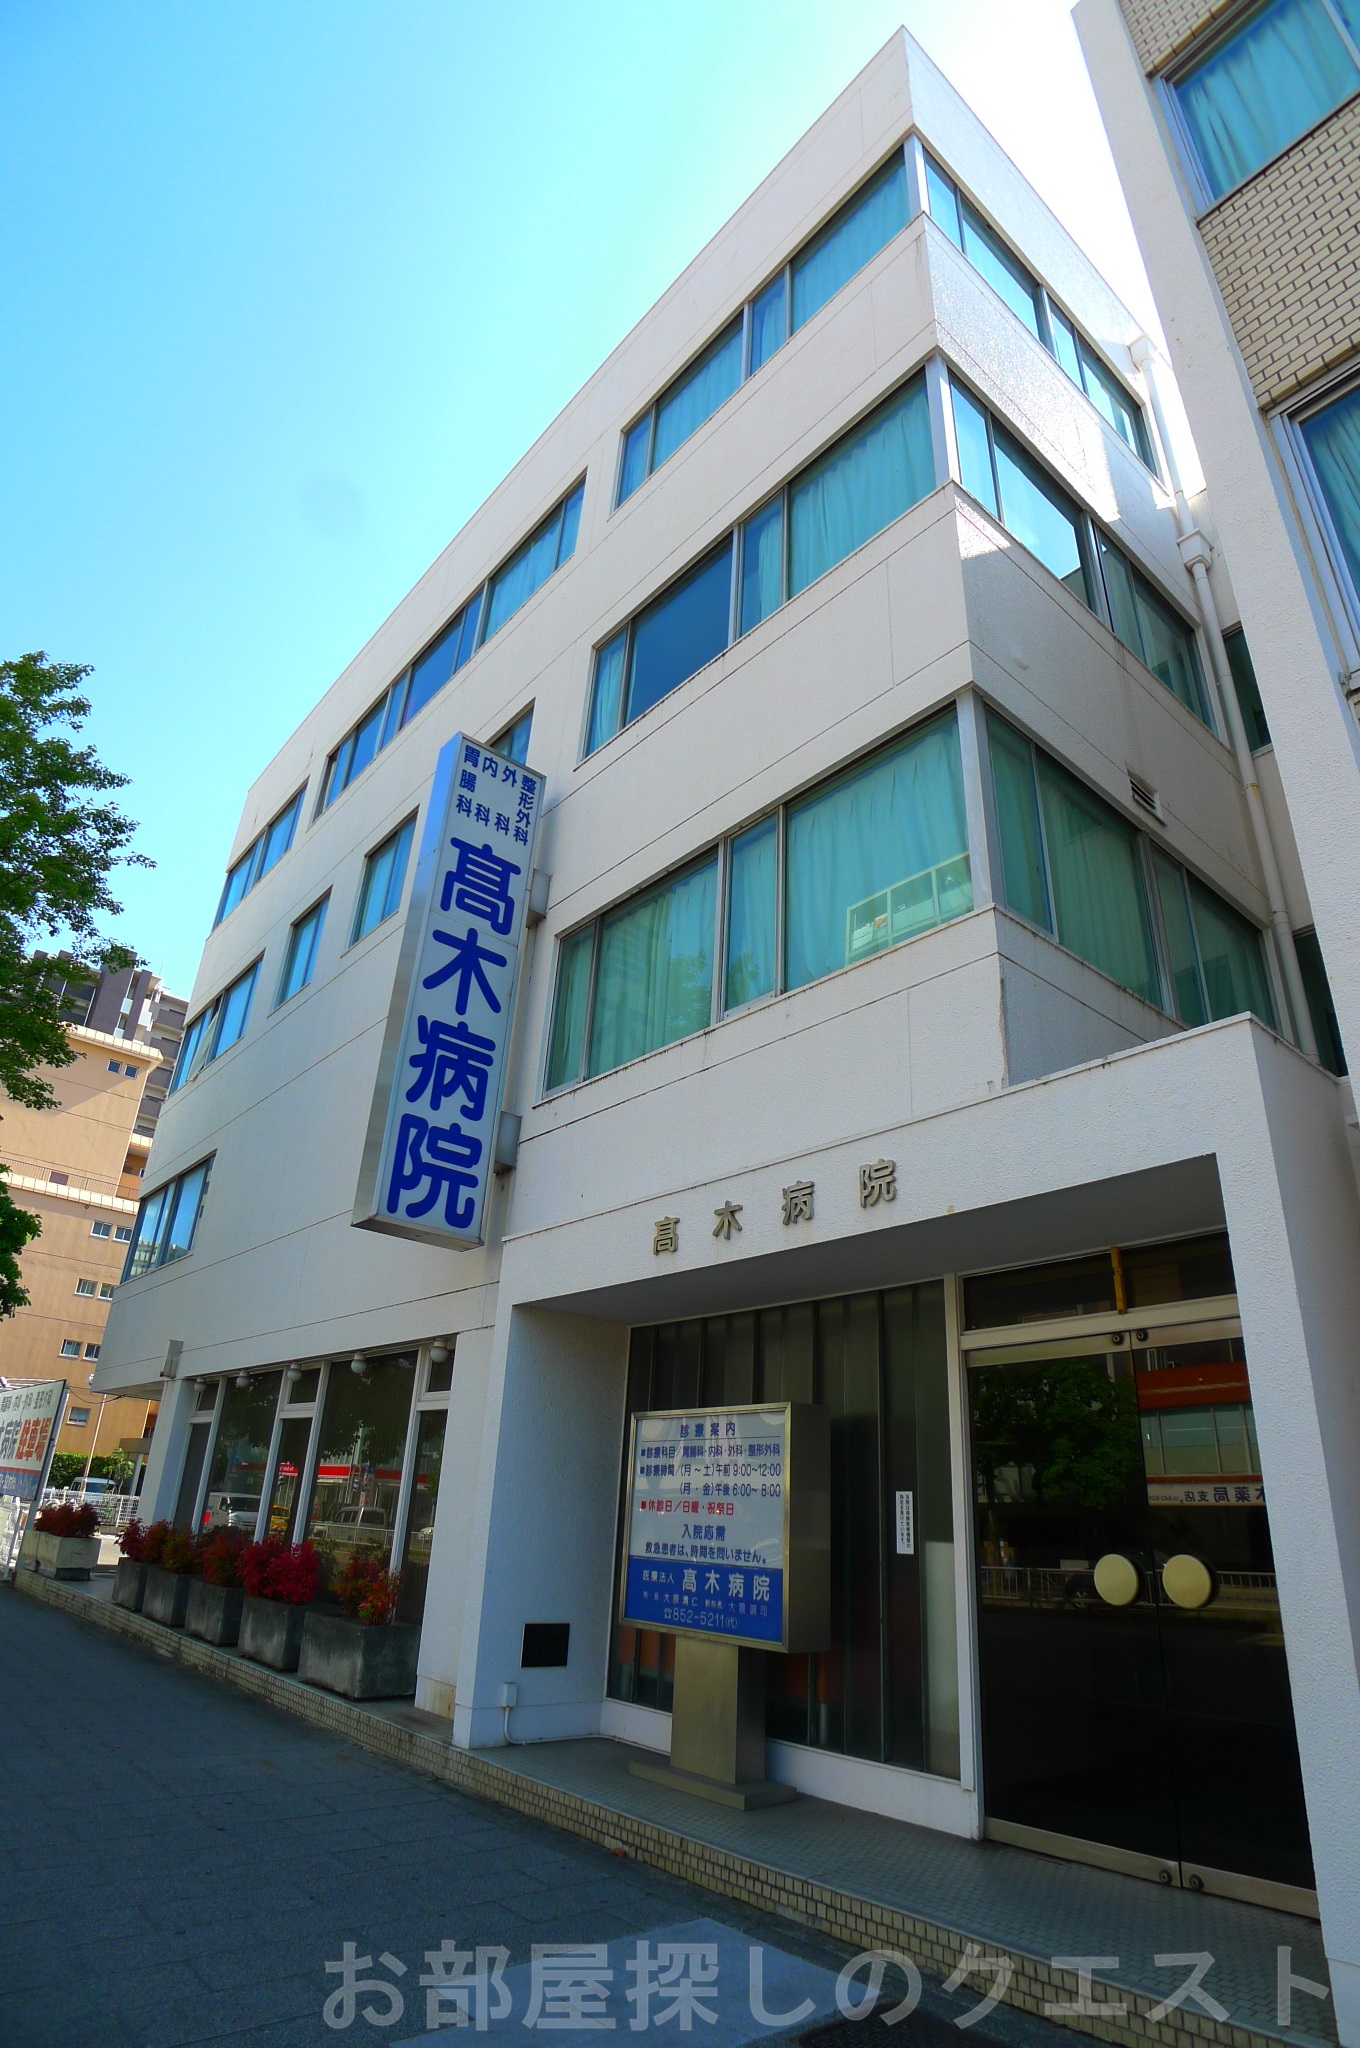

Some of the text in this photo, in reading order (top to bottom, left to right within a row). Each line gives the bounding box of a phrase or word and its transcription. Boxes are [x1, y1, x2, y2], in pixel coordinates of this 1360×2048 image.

[456, 745, 481, 818] 胃腸科
[474, 756, 498, 827] 内科
[494, 765, 518, 836] 外科
[513, 774, 537, 846] 整形外科
[680, 1421, 737, 1438] 診療案内
[682, 1523, 727, 1542] 入院応需
[642, 1569, 675, 1585] 医療法人
